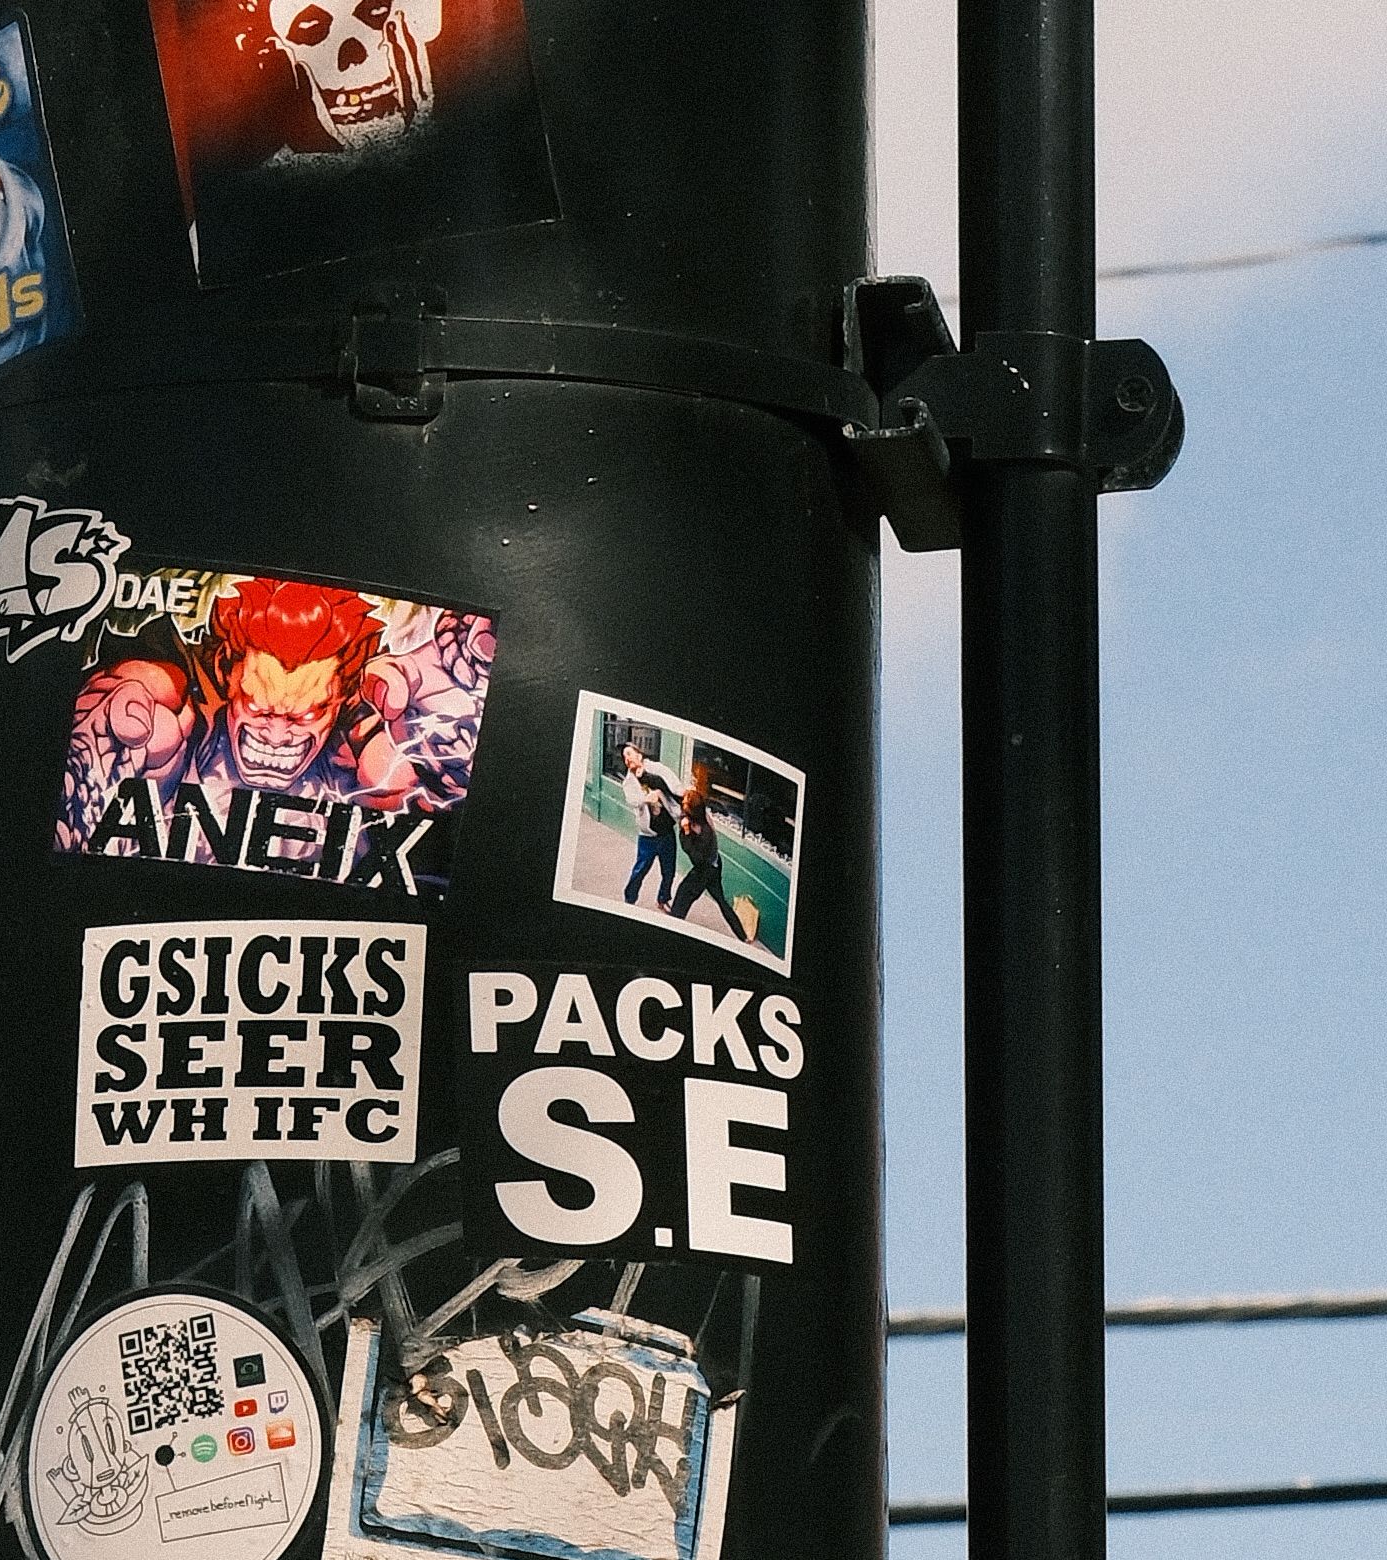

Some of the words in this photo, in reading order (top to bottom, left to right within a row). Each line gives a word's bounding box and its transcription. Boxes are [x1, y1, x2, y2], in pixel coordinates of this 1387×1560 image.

[99, 935, 407, 1020] GSICKS
[94, 1020, 405, 1093] SEER
[467, 971, 805, 1080] PACKS
[93, 1097, 228, 1145] WH
[252, 1097, 401, 1143] IFC
